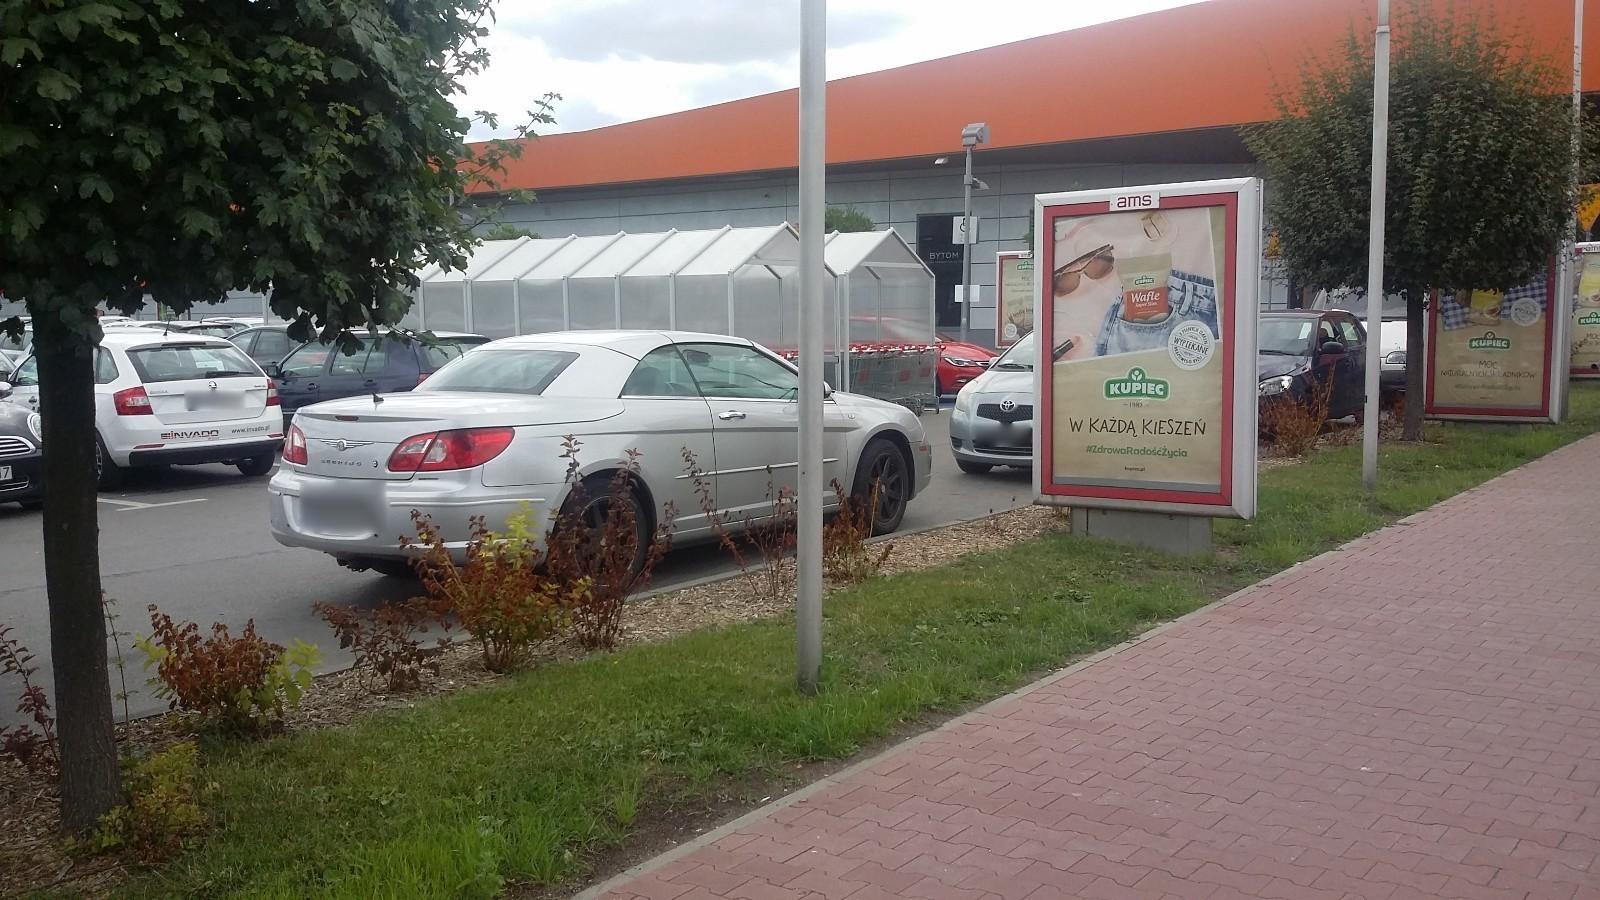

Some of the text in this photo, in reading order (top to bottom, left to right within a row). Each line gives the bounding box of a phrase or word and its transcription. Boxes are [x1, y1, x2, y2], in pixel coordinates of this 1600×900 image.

[1117, 195, 1152, 208] ams
[929, 252, 959, 260] BYTOM
[1131, 290, 1160, 303] Wafle
[1174, 336, 1209, 355] WYPIEKANE
[1471, 339, 1508, 347] KUPIEC
[1478, 360, 1497, 369] MOC
[1109, 382, 1165, 395] KUPIEC
[1069, 416, 1207, 437] W KAŻDĄ KIESZEŃ
[1086, 445, 1188, 458] #ZdrowaRadośćŻycia
[0, 467, 9, 478] 7
